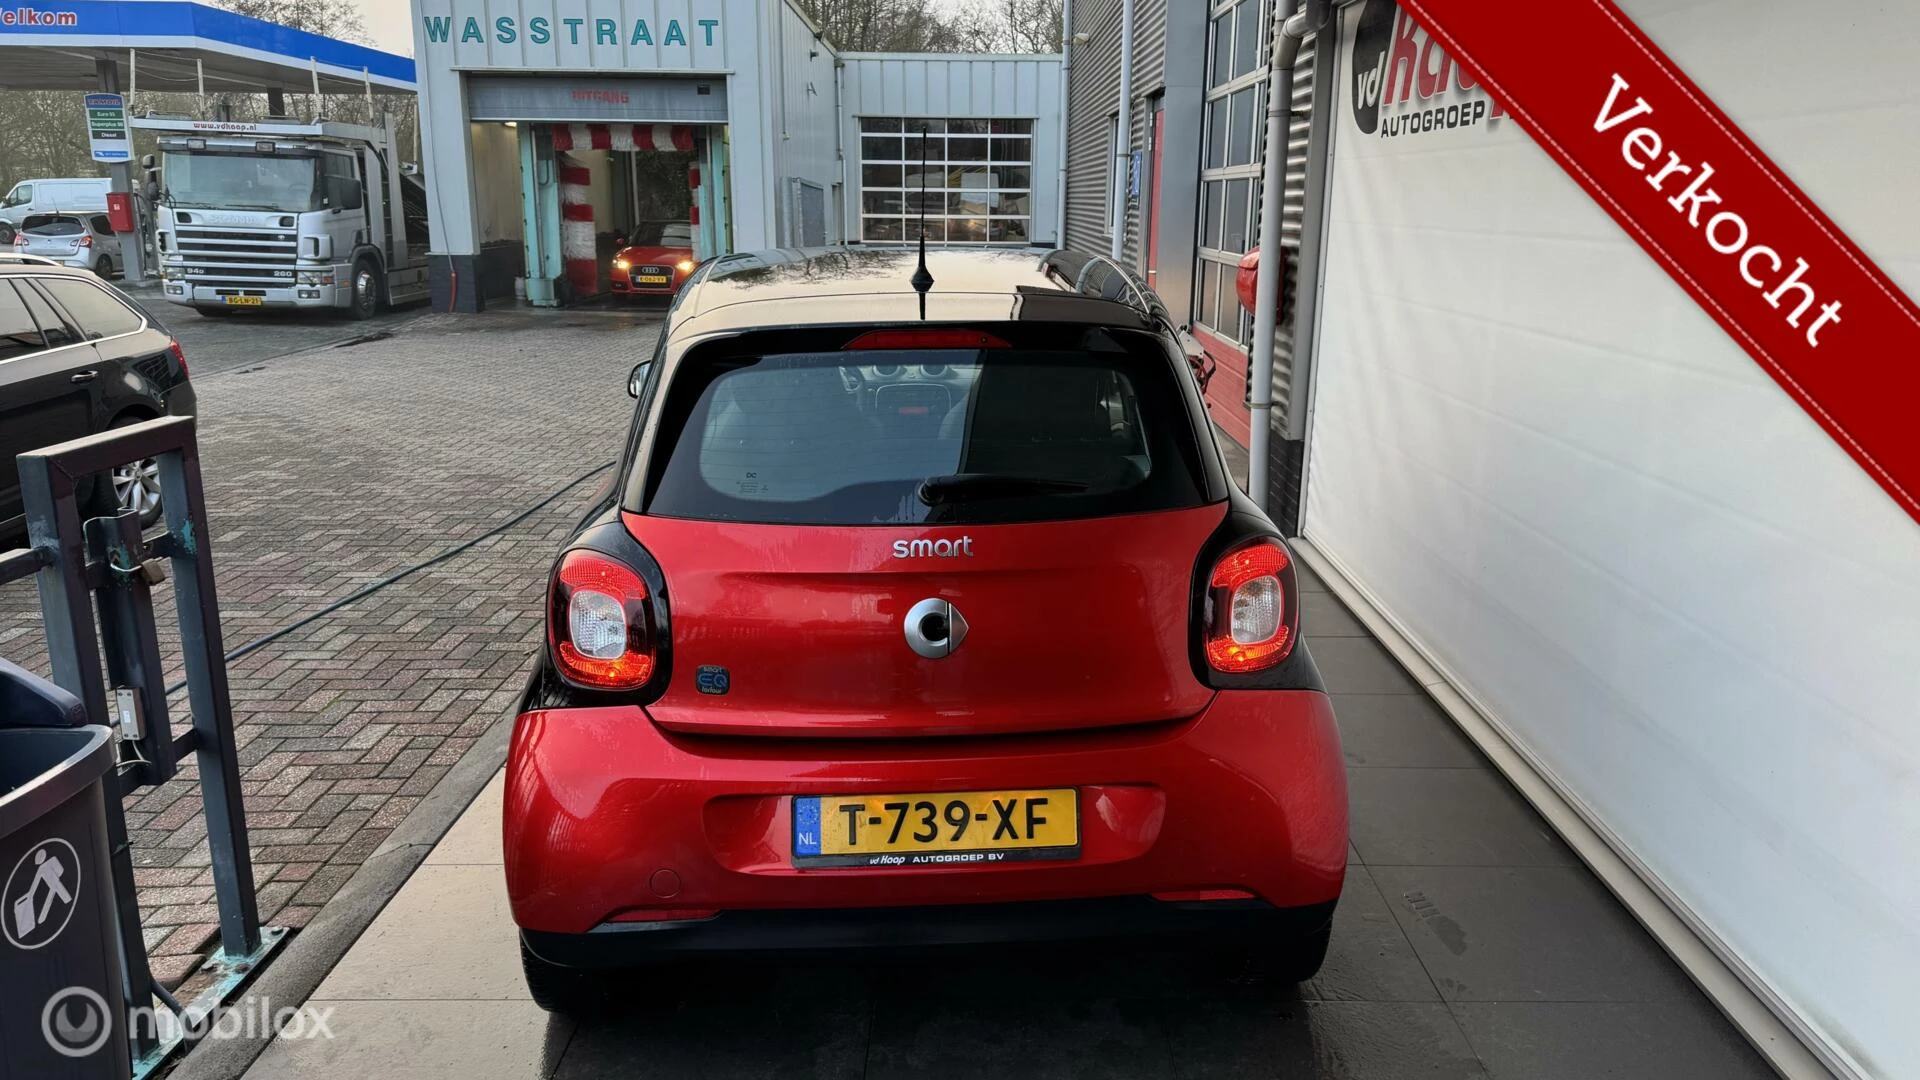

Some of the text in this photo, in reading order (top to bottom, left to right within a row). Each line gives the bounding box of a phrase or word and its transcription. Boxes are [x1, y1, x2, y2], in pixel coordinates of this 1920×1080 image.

[0, 7, 77, 26] elkom
[424, 16, 719, 46] WASSTRAAT
[1381, 100, 1485, 138] AUTOGROEP
[893, 536, 974, 558] smart
[839, 797, 1049, 846] T-739-XF
[798, 832, 818, 845] NL
[912, 853, 985, 864] AUTOGROEP
[987, 852, 1005, 861] BV
